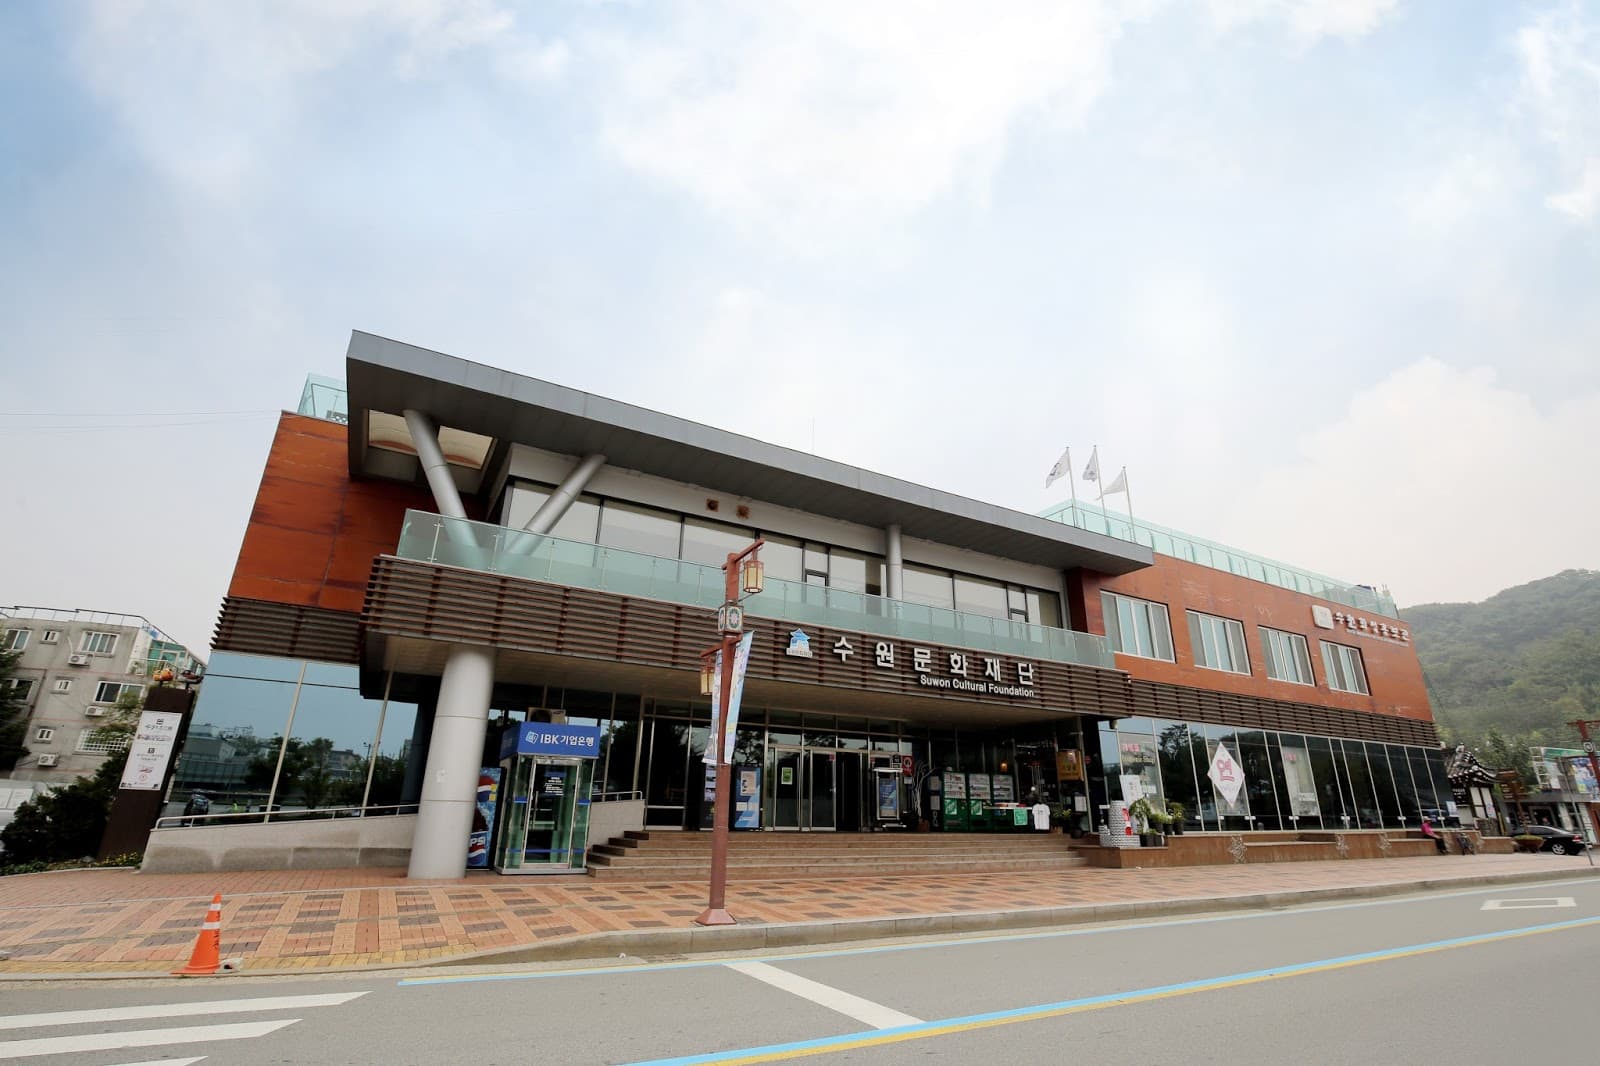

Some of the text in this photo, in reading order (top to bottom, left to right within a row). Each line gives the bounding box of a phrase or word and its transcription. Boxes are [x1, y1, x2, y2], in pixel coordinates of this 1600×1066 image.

[833, 636, 1034, 686] 수원문화재단
[920, 674, 1034, 697] Suwon Cultural Foundation
[539, 733, 594, 747] IBK 기업은행
